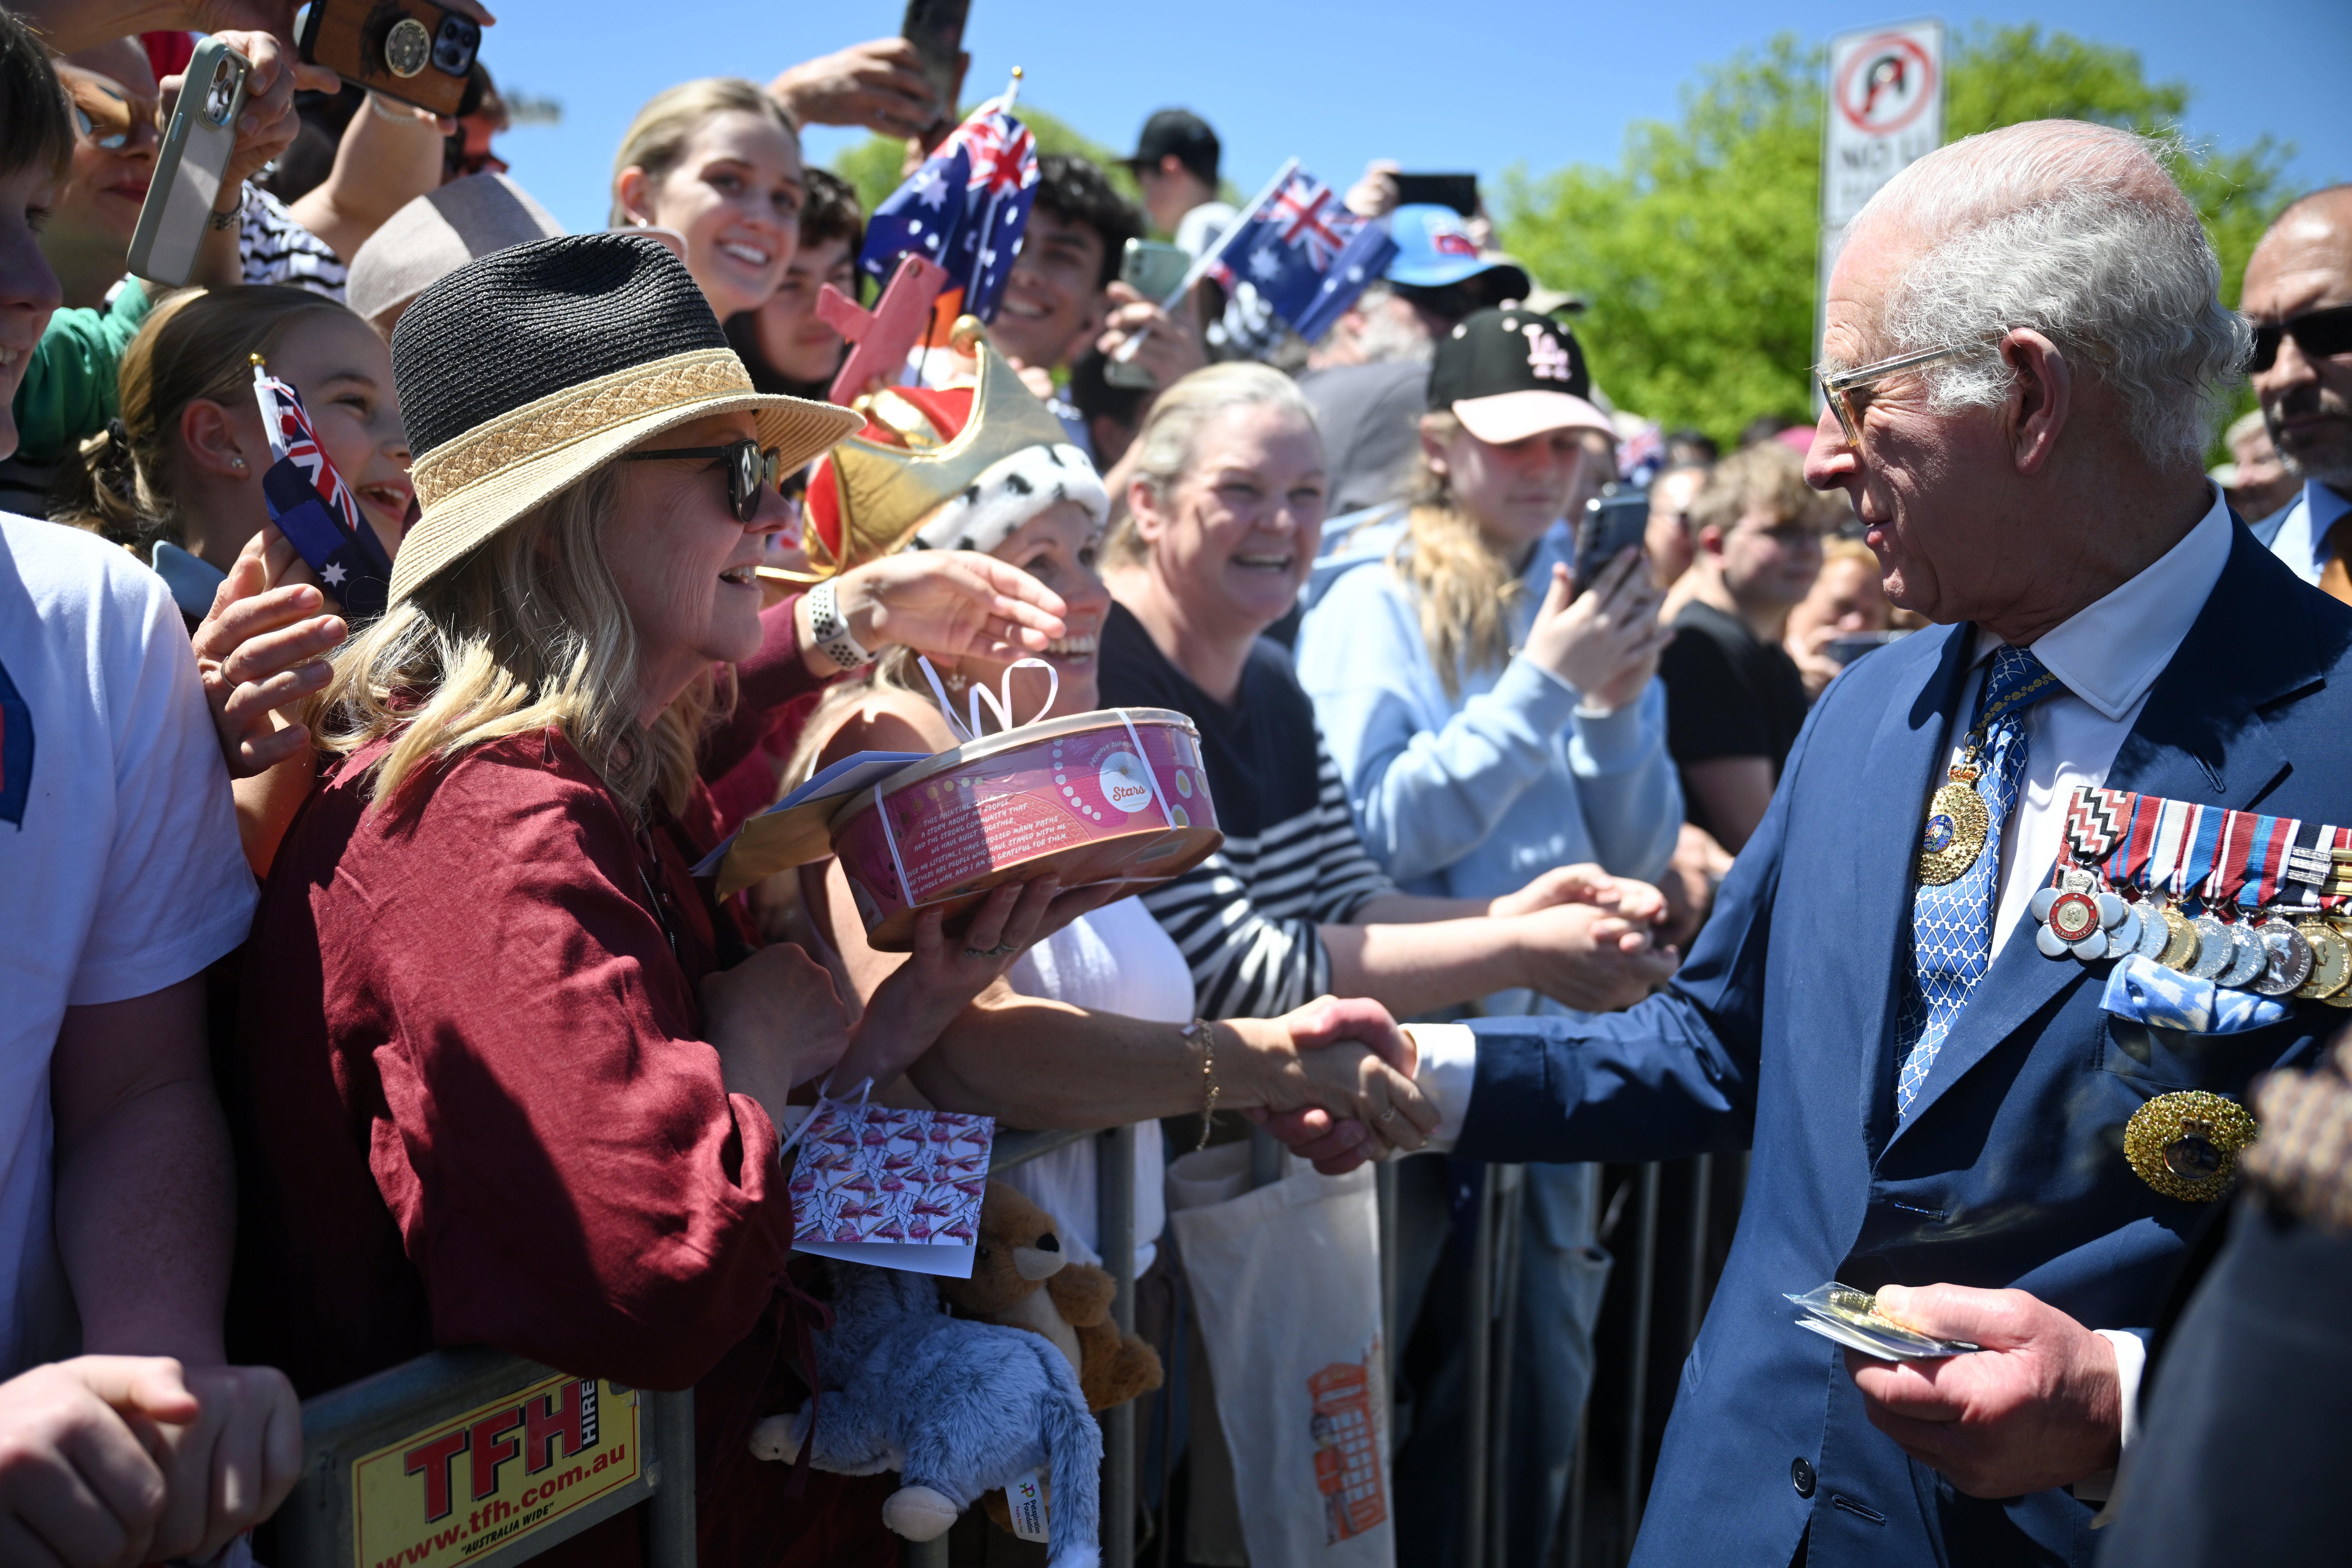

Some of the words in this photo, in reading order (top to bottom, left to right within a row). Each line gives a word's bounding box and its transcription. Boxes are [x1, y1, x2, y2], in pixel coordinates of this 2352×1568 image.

[1522, 324, 1572, 382] LA
[1090, 743, 1110, 768] PROUDLY
[1113, 786, 1146, 801] Stars
[915, 842, 926, 852] AND
[927, 836, 939, 846] THE
[940, 825, 965, 840] STRONG
[967, 809, 1007, 829] COMMUNITY
[1008, 803, 1027, 814] THAT
[923, 815, 937, 827] THIS
[940, 803, 971, 820] PAINTING
[927, 822, 946, 835] STORY
[948, 812, 970, 827] ABOUT
[972, 808, 982, 816] MY
[984, 799, 1009, 813] PEOPLE
[942, 838, 957, 849] HAVE
[959, 830, 977, 842] BUILT
[980, 817, 1016, 834] TOGETHER.
[906, 868, 918, 879] OVER
[963, 841, 980, 852] HAVE
[982, 830, 1010, 846] CROSSED
[1013, 823, 1033, 834] MANY
[1036, 816, 1058, 828] PATHS
[917, 871, 934, 882] THERE
[936, 865, 947, 875] ARE
[948, 855, 971, 869] PEOPLE
[972, 849, 987, 859] WHO
[989, 842, 1006, 852] HAVE
[1008, 833, 1034, 846] STAYED
[1037, 827, 1054, 837] WITH
[920, 880, 938, 893] WHOLE
[956, 866, 968, 876] AND
[976, 860, 985, 868] AM
[997, 844, 1031, 860] GRATEFUL
[1048, 833, 1068, 844] THEM.
[2055, 927, 2072, 937] PUBLIC
[2076, 918, 2094, 937] SERVICES
[581, 1380, 596, 1445] HIRE
[405, 1379, 585, 1524] TFH
[376, 1443, 625, 1568] www.tfh.com.au
[1024, 1502, 1033, 1533] Foundation
[1030, 1499, 1040, 1533] Petspiration
